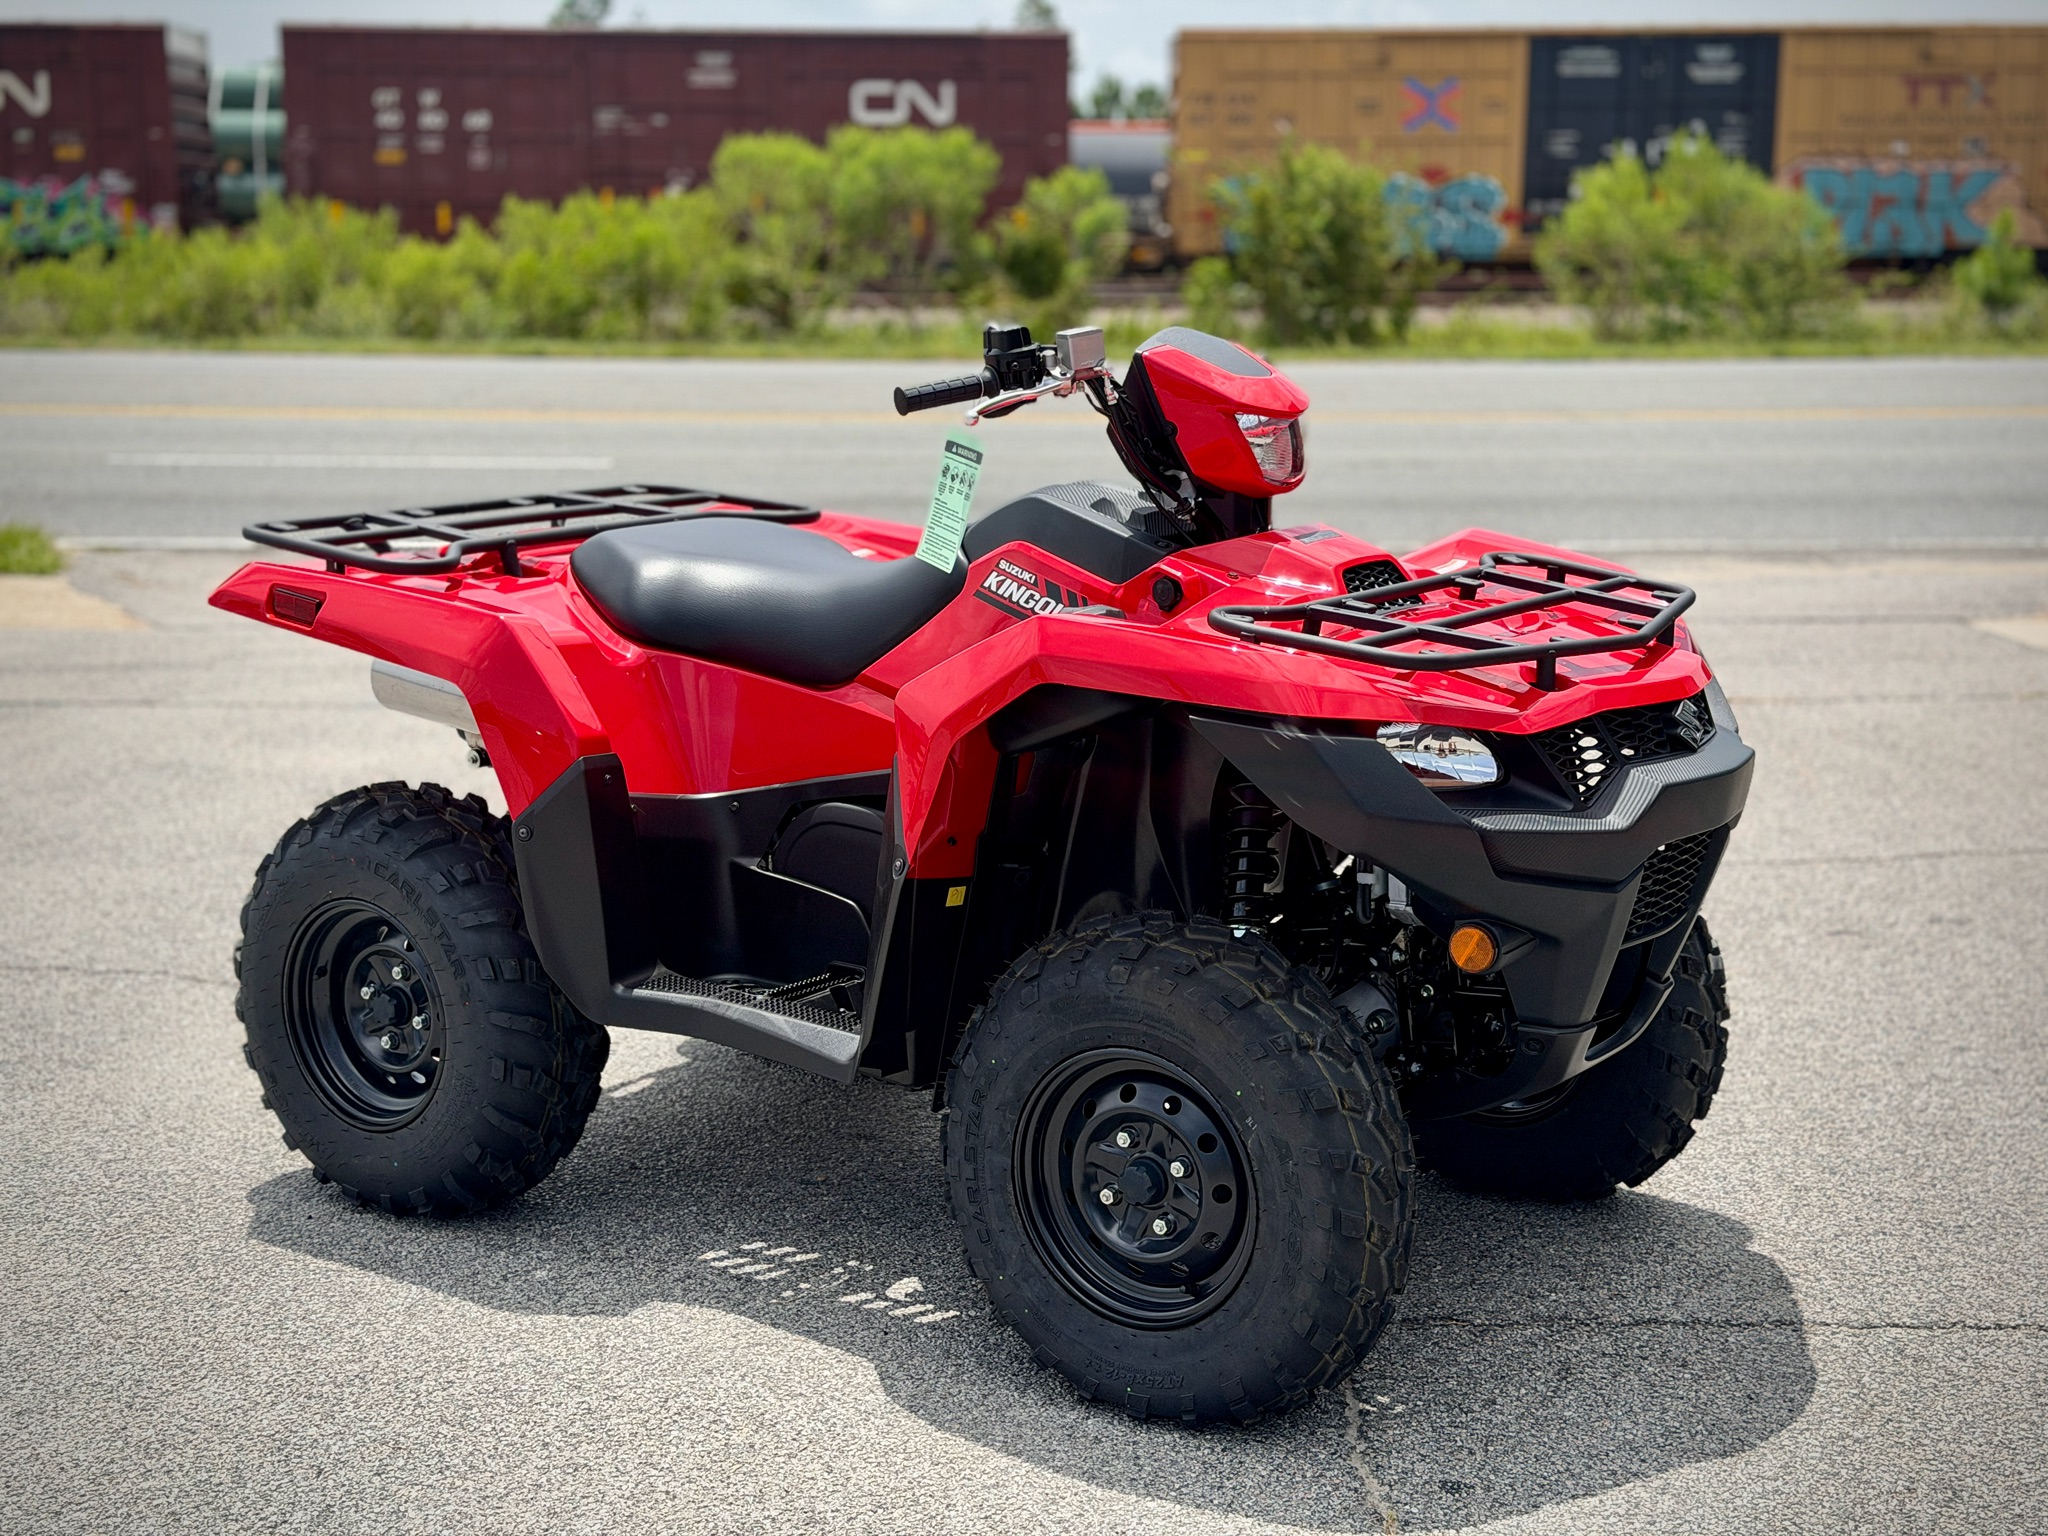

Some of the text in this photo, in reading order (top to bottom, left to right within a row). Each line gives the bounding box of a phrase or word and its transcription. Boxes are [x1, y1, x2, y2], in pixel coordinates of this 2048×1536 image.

[849, 79, 957, 127] CN
[998, 559, 1037, 584] SUZUKI
[374, 860, 466, 981] CARLSTAR
[964, 1087, 993, 1246] CARLSTAR
